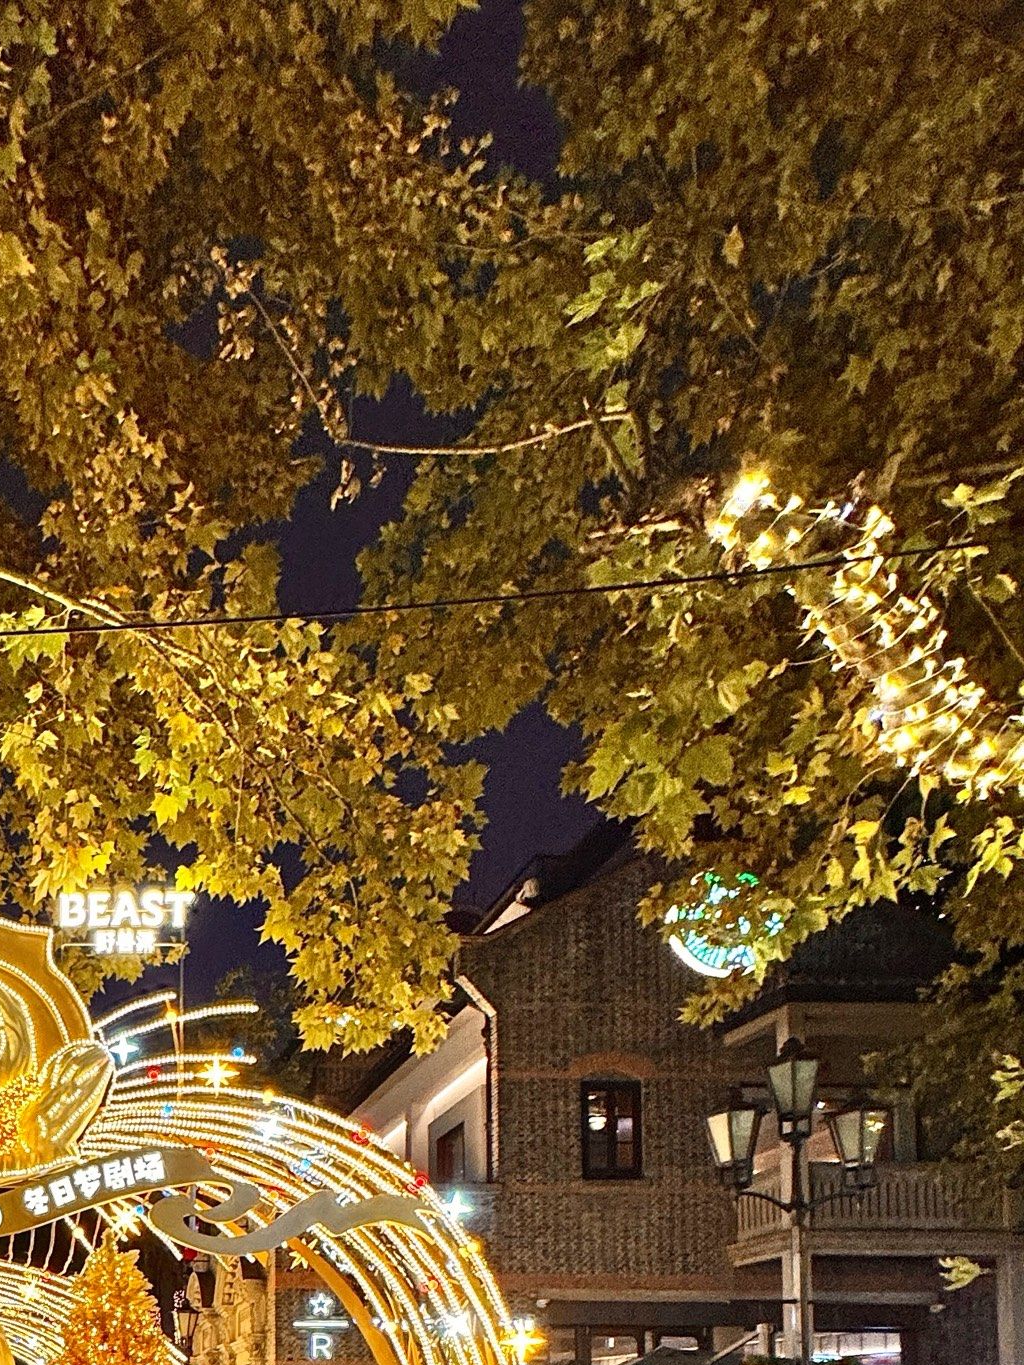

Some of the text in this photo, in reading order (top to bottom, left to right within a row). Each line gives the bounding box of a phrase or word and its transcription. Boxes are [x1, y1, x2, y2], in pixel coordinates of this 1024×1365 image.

[58, 889, 195, 929] BEAST
[24, 1151, 165, 1216] 冬日梦剧场
[310, 1333, 333, 1360] R
